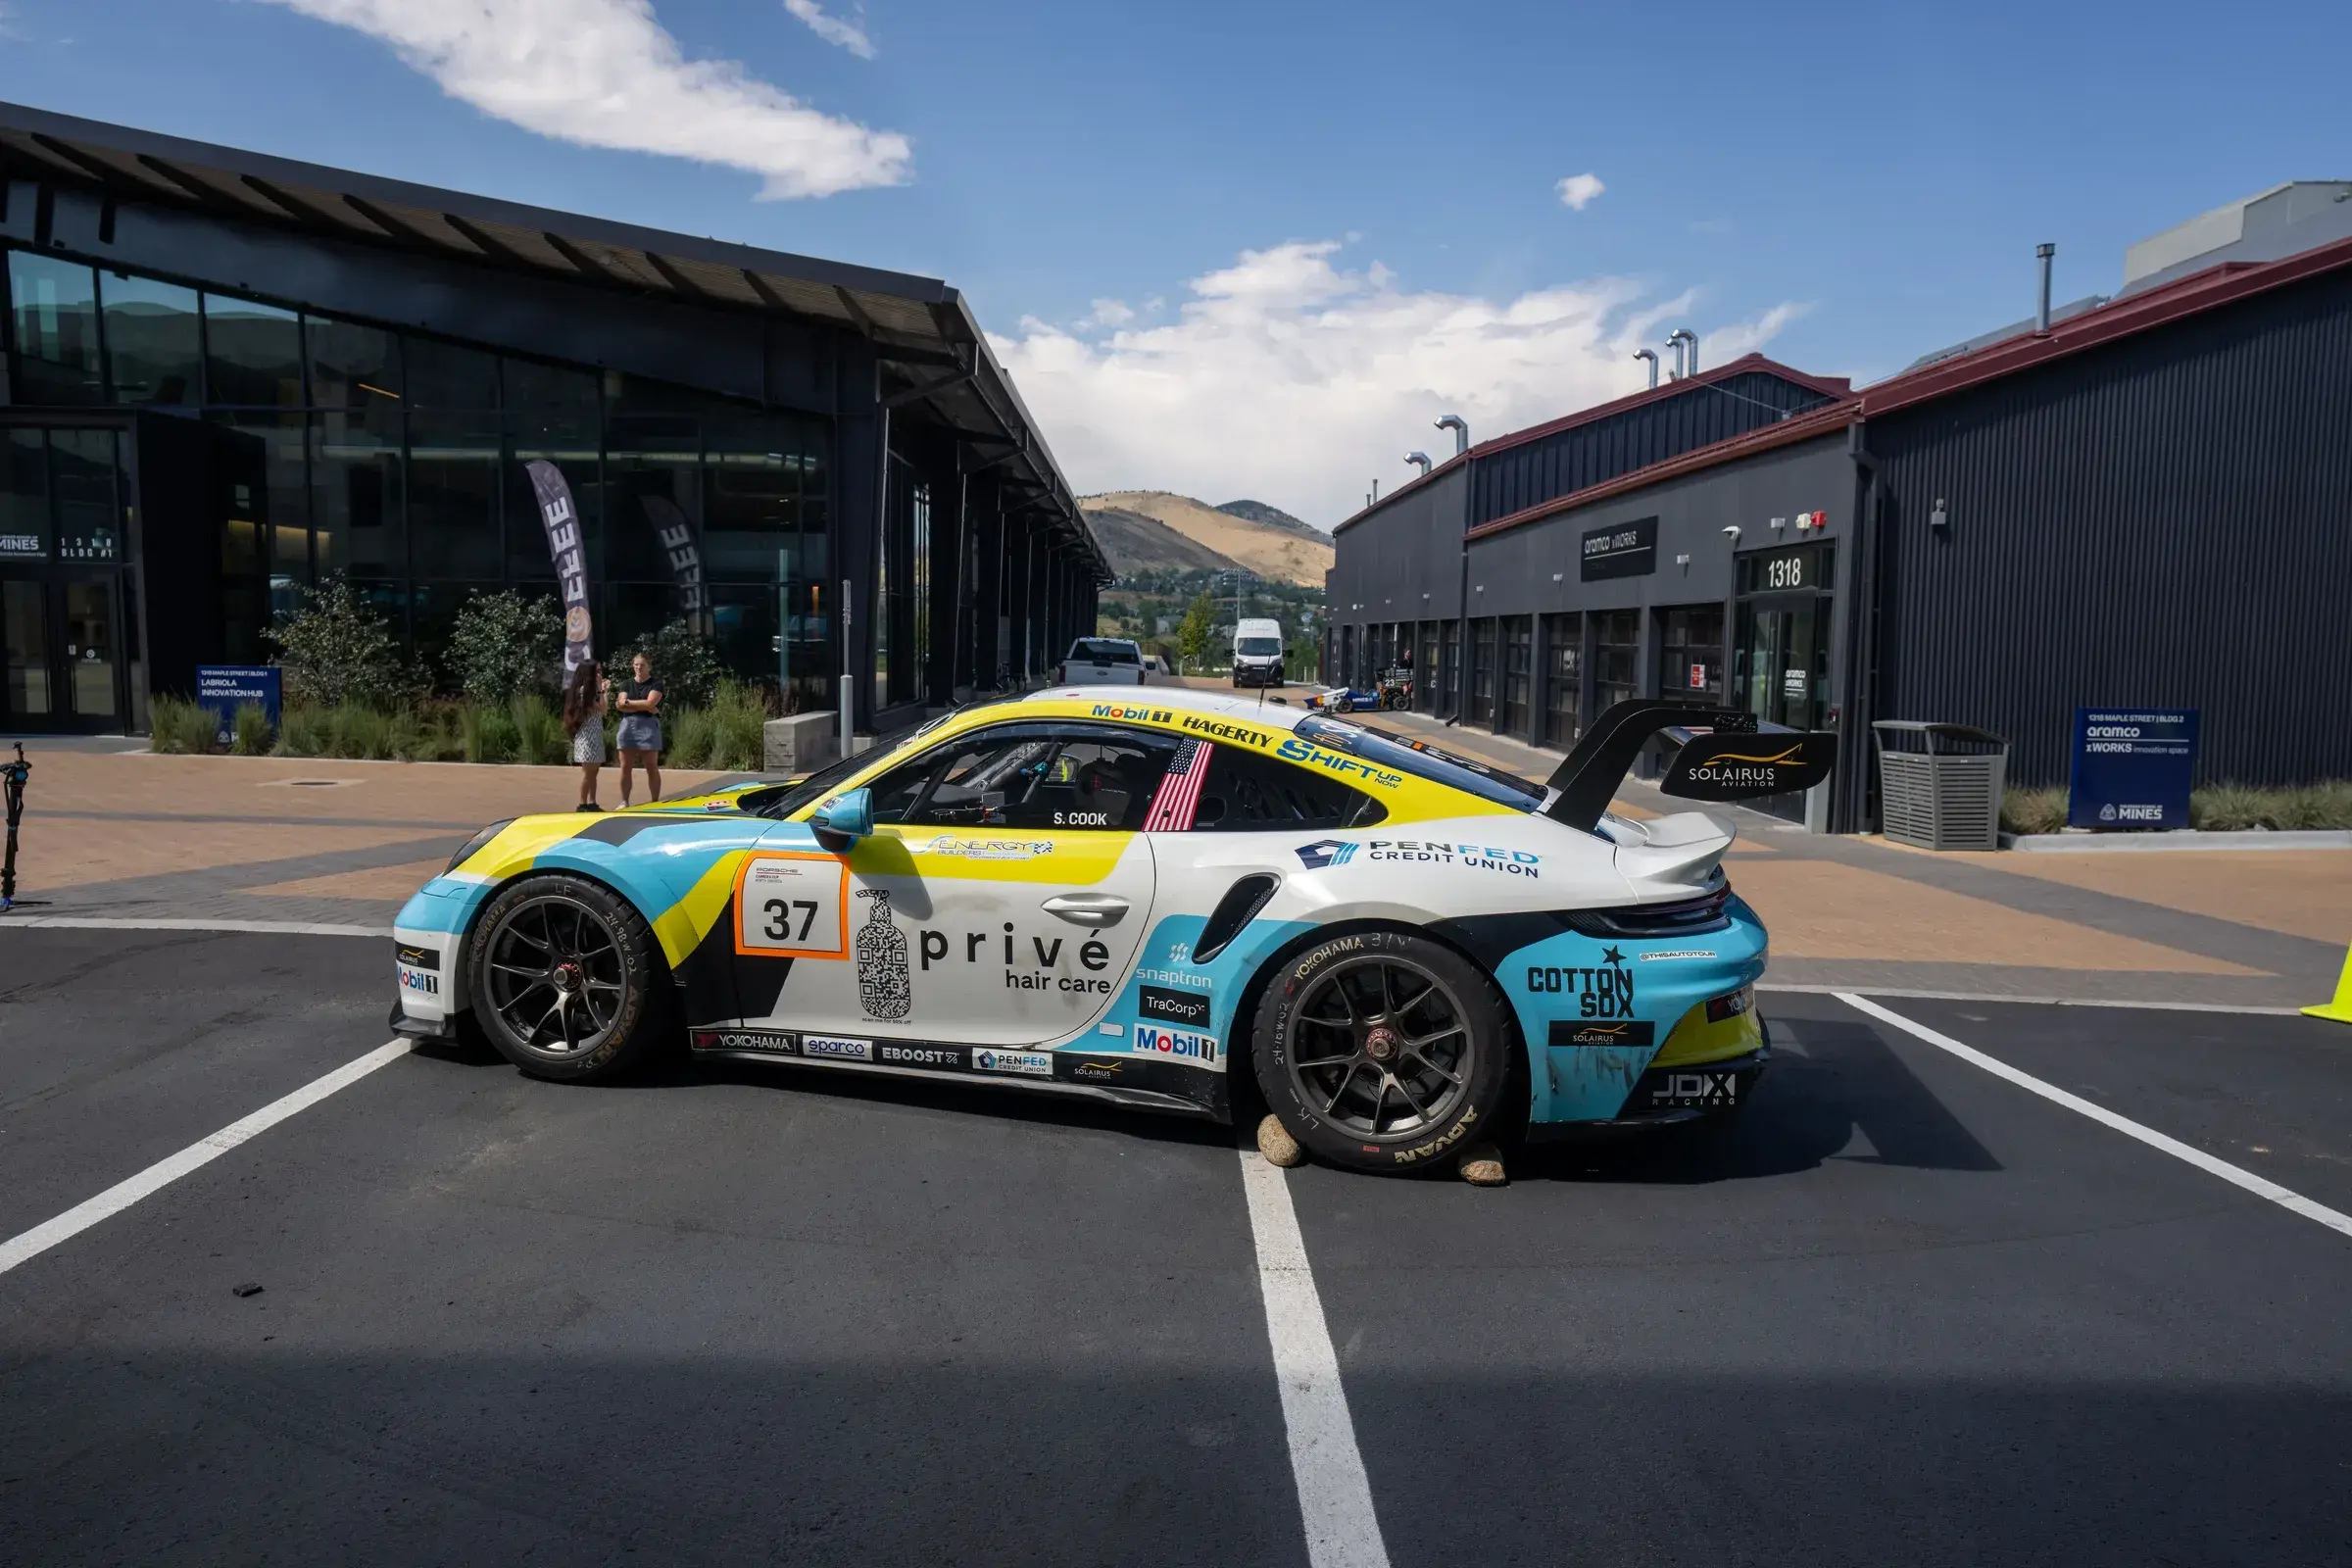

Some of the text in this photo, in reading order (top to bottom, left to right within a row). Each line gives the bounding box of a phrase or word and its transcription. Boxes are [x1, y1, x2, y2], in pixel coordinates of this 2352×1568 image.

[61, 548, 93, 557] BLDG
[1585, 535, 1610, 554] aramco
[1768, 558, 1801, 587] 1318
[1092, 705, 1150, 721] Mobil
[1182, 715, 1274, 748] HAGERTY
[2086, 726, 2140, 737] aramco
[2085, 743, 2132, 753] xWORKS
[1276, 739, 1379, 778] SHIFT
[1377, 770, 1402, 783] UP
[1689, 767, 1775, 780] SOLAIRUS
[1374, 777, 1399, 789] NOW
[1054, 812, 1107, 826] S. COOK
[2119, 808, 2163, 819] MINES
[939, 840, 1034, 851] ENERGY
[1369, 841, 1540, 864] PENFED
[1369, 851, 1539, 878] CREDIT UNION
[763, 899, 818, 942] 37
[920, 922, 1109, 971] privé
[1294, 936, 1365, 980] YOKOHAMA
[1641, 951, 1716, 960] @THISAUTOTOUR
[1005, 969, 1111, 995] hair care
[1136, 968, 1212, 989] snaptron
[1528, 967, 1634, 994] COTTON
[1147, 996, 1197, 1016] TraCorp
[1580, 992, 1635, 1018] SOX
[719, 1035, 793, 1051] YOKOHAMA
[808, 1039, 864, 1054] sparco
[1137, 1028, 1199, 1057] Mobil
[882, 1047, 944, 1063] EBOOST
[998, 1054, 1047, 1066] PENFED
[1074, 1068, 1111, 1077] SOLAIRUS
[1652, 1074, 1736, 1098] JDX
